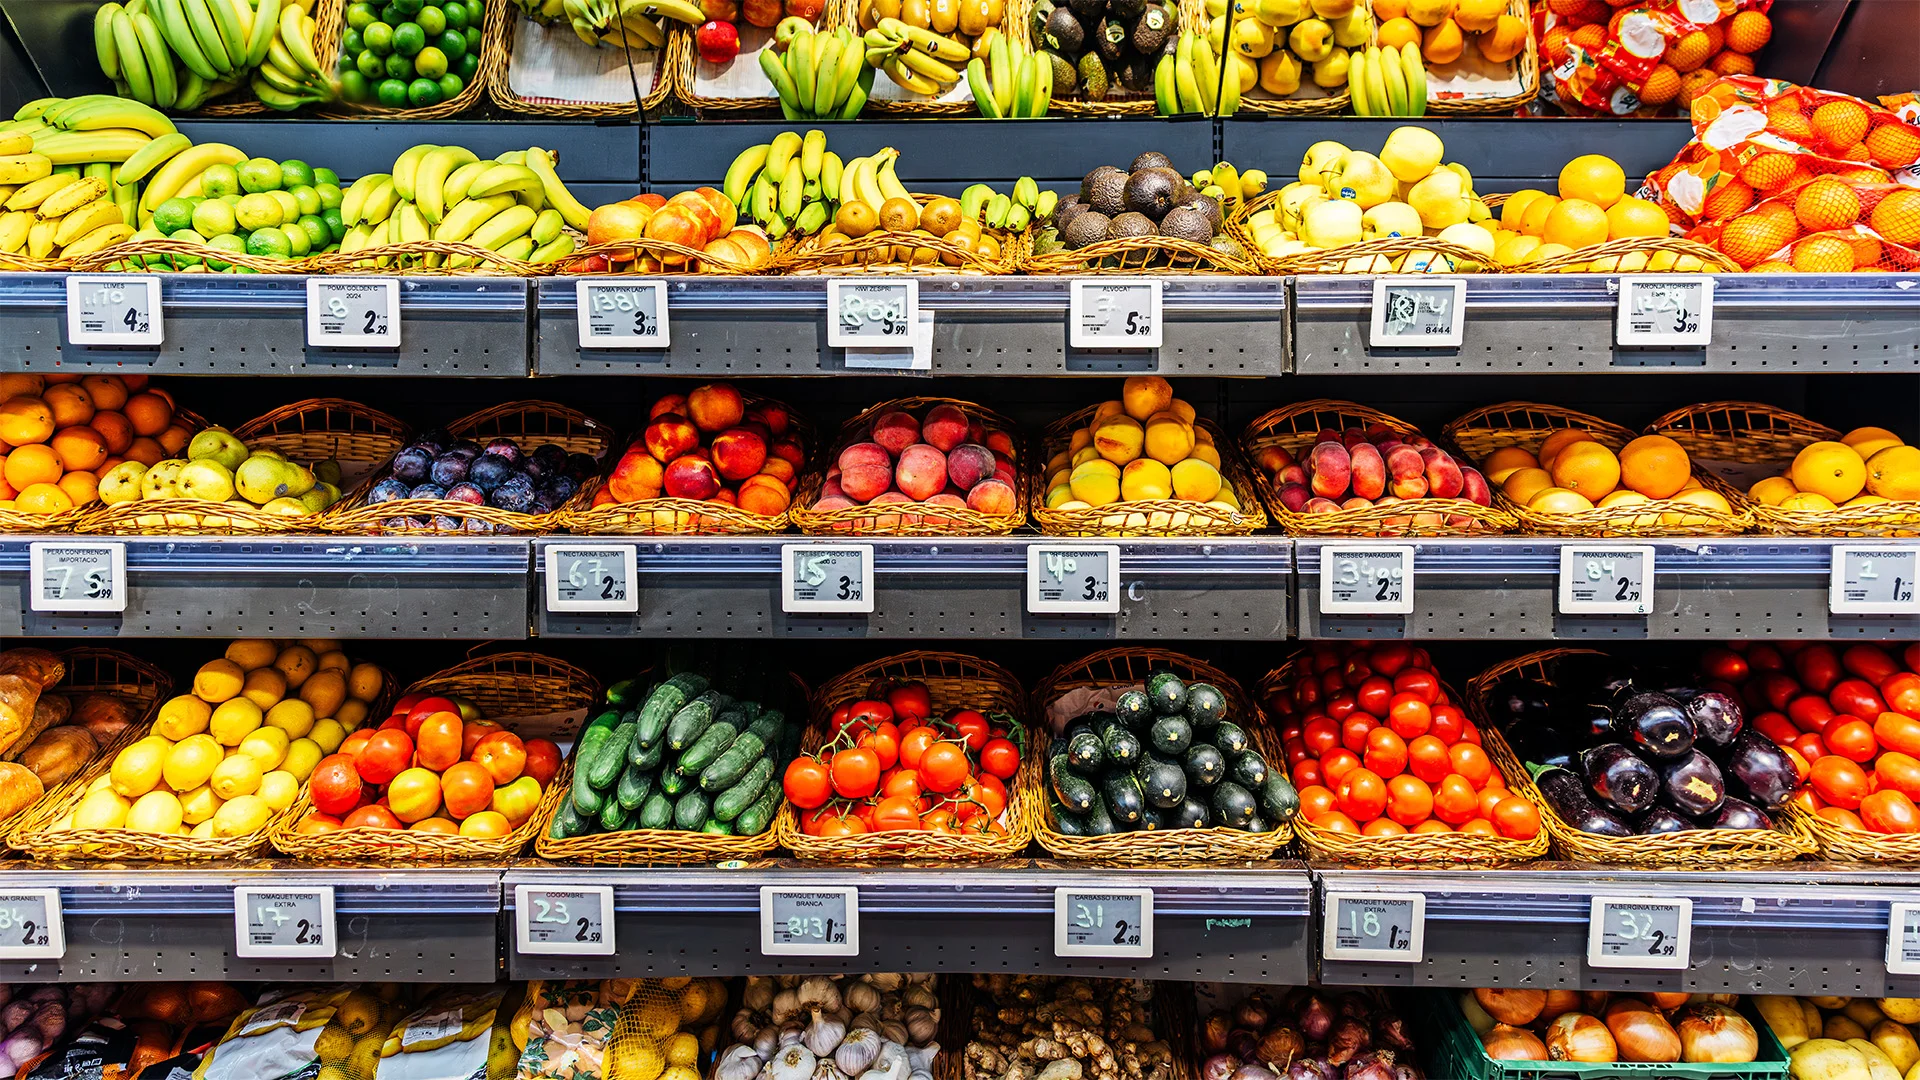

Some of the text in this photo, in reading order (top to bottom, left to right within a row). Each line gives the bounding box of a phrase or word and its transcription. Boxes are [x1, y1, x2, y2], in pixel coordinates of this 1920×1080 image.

[328, 297, 348, 318] 8
[569, 560, 608, 588] 67
[1586, 560, 1615, 580] 84
[257, 907, 291, 927] 17
[534, 900, 570, 924] 23
[1076, 904, 1103, 928] 31
[1351, 910, 1380, 937] 18
[1619, 910, 1660, 940] 32
